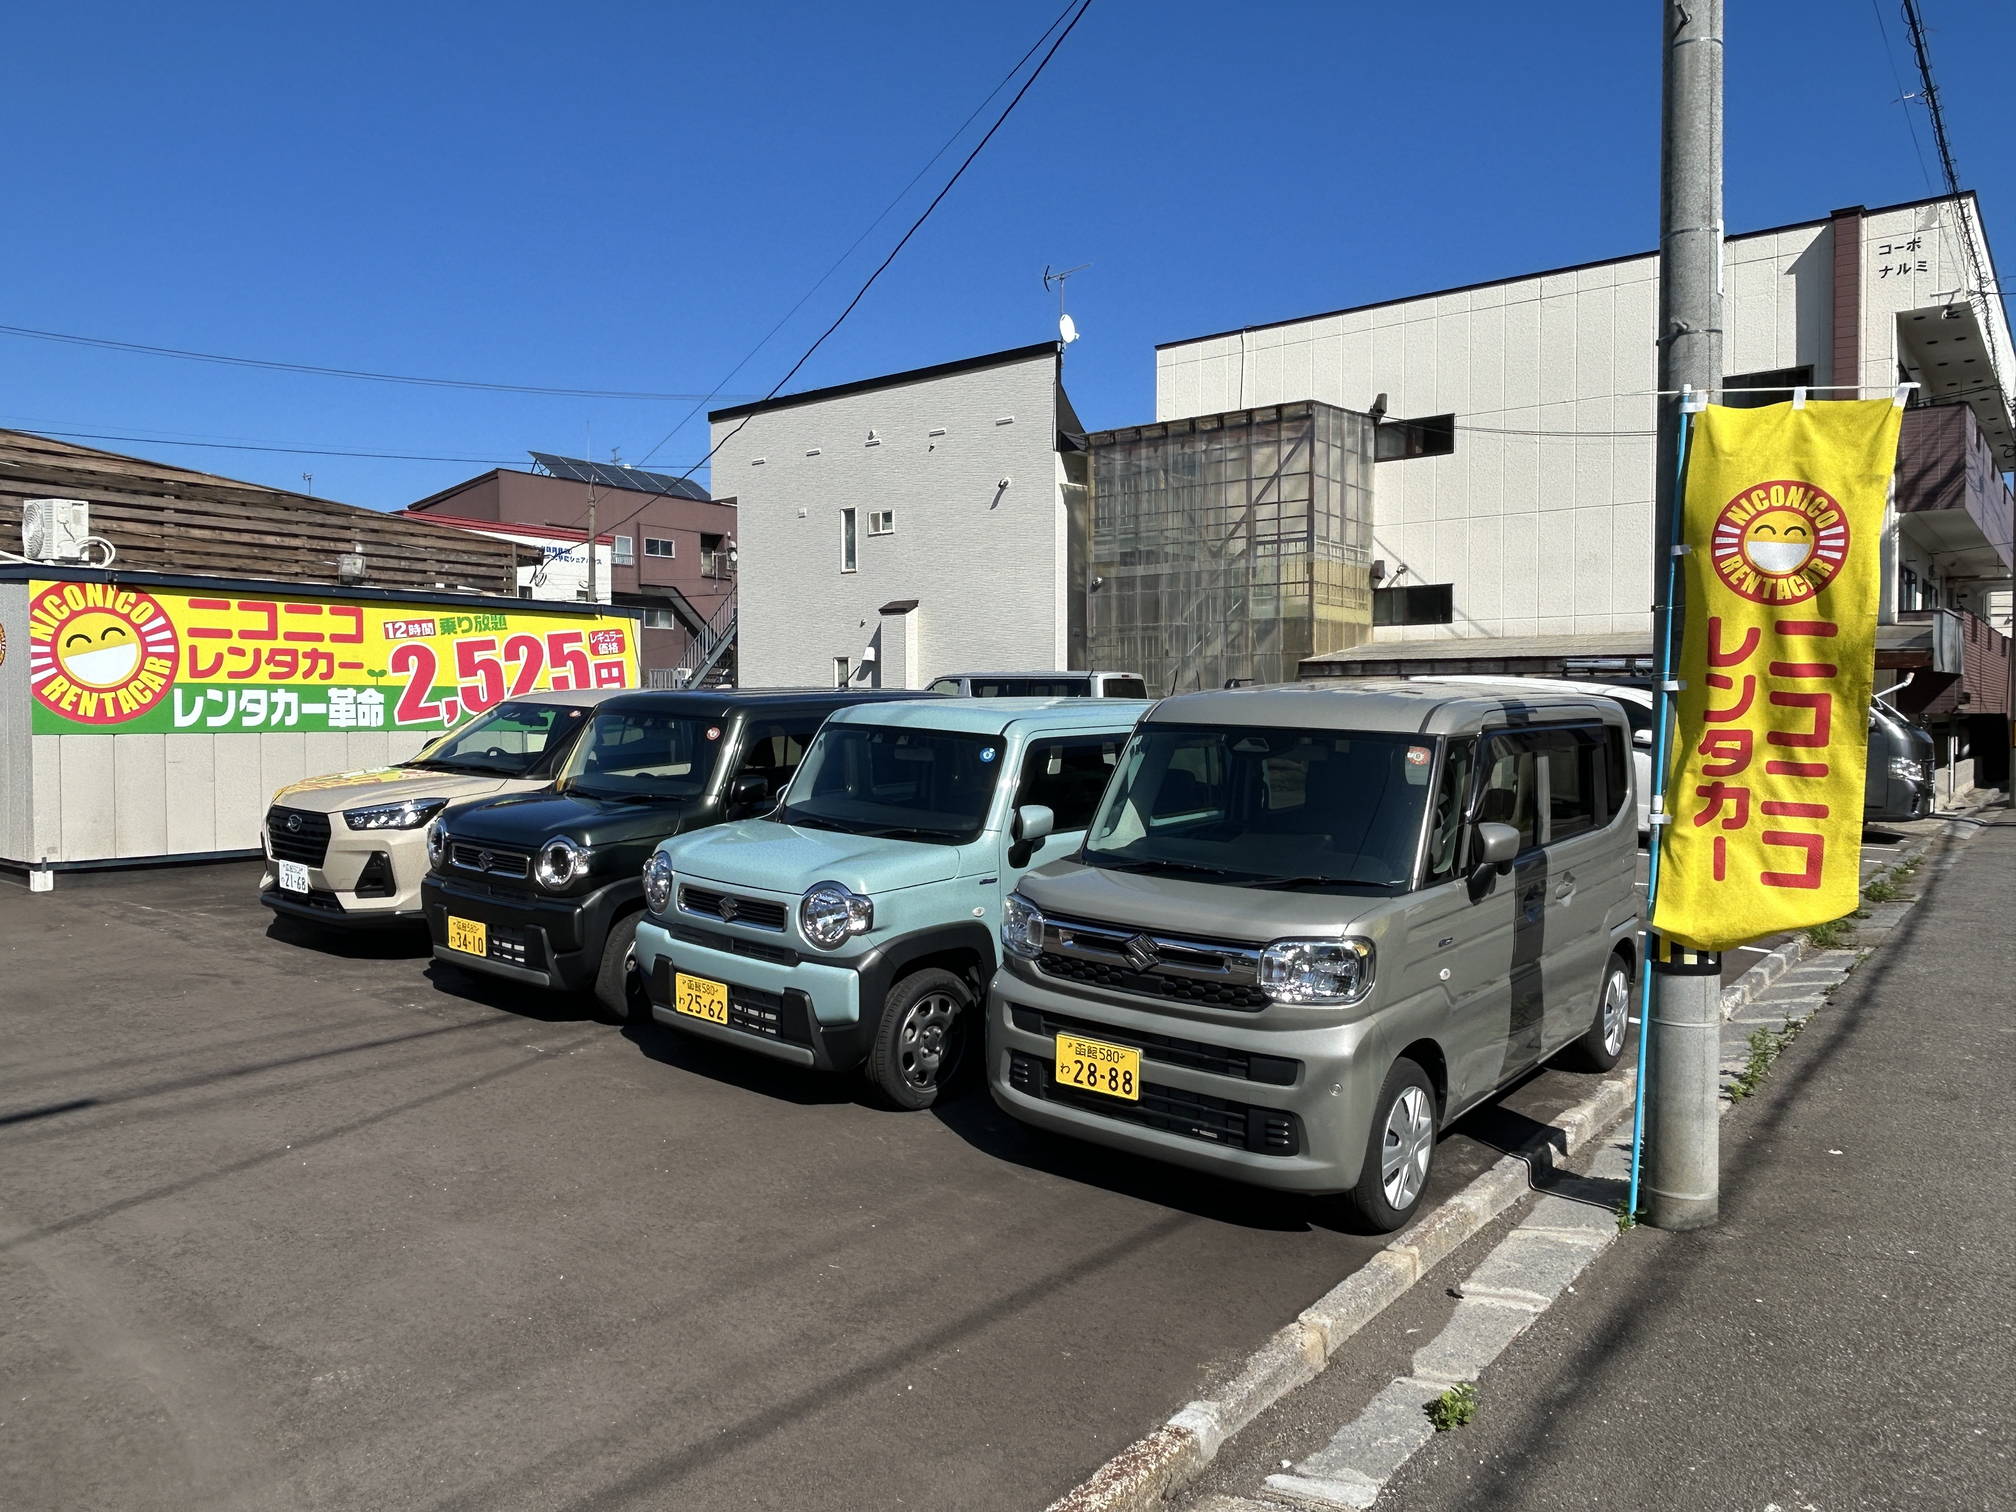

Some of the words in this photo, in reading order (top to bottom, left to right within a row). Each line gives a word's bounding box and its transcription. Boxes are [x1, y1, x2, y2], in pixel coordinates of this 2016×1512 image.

[1879, 237, 1922, 256] コーポ
[1879, 261, 1928, 279] ナルミ
[1726, 485, 1840, 530] NICONICO
[1719, 554, 1835, 600] RENTACAR
[30, 583, 155, 642] NICONICO
[187, 598, 363, 643] ニコニコ
[385, 621, 435, 639] 12時間
[439, 614, 508, 636] 乗り放題
[590, 631, 623, 645] レギュラー
[598, 643, 619, 654] 価格
[189, 644, 364, 680] レンタカー
[41, 656, 173, 718] RENTACAR
[173, 688, 385, 728] レンタカー革命
[1693, 616, 1761, 881] レンタカー
[1760, 620, 1839, 889] ニコニコ
[687, 993, 724, 1021] 25-62
[1073, 1059, 1133, 1095] 28-88
